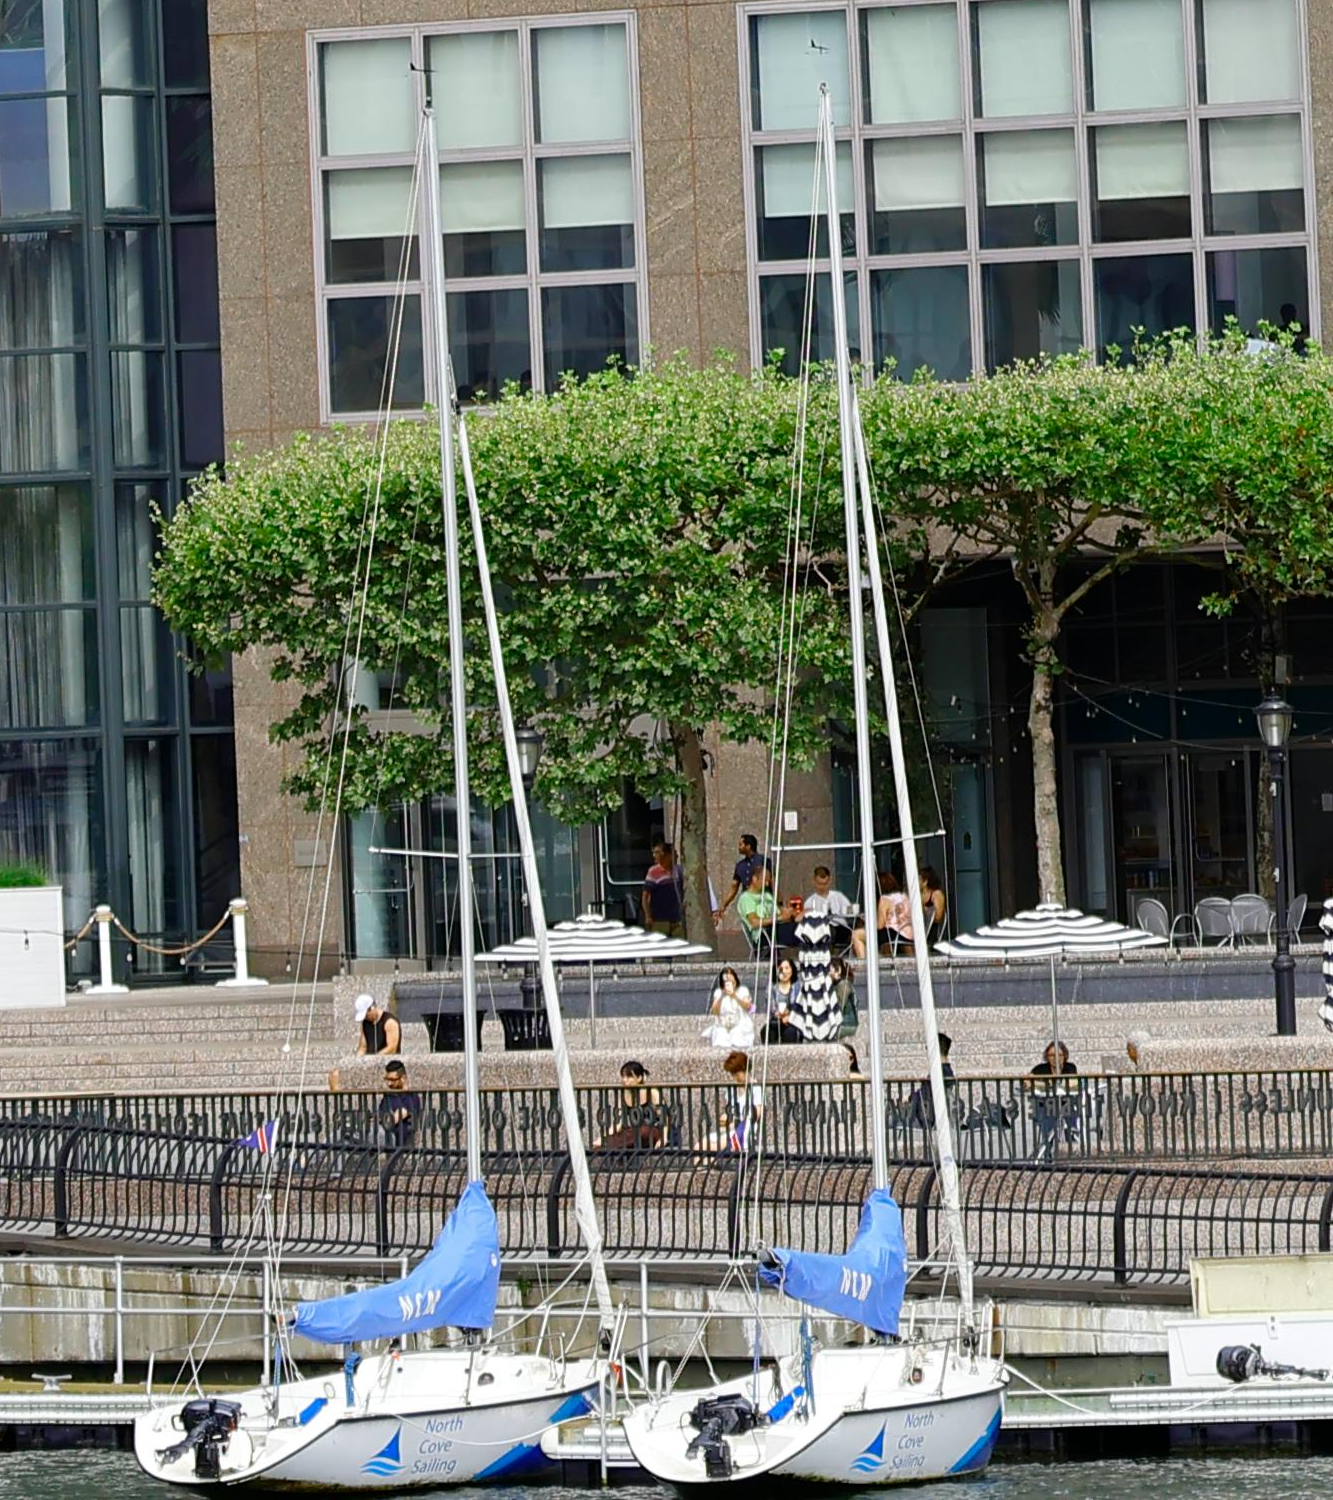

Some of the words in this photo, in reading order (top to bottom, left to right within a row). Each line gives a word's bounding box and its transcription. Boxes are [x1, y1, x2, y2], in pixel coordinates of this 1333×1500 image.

[425, 1416, 463, 1432] North
[904, 1410, 934, 1428] North
[419, 1440, 453, 1454] Cove
[897, 1435, 925, 1449] Cove
[411, 1458, 457, 1474] Sailing
